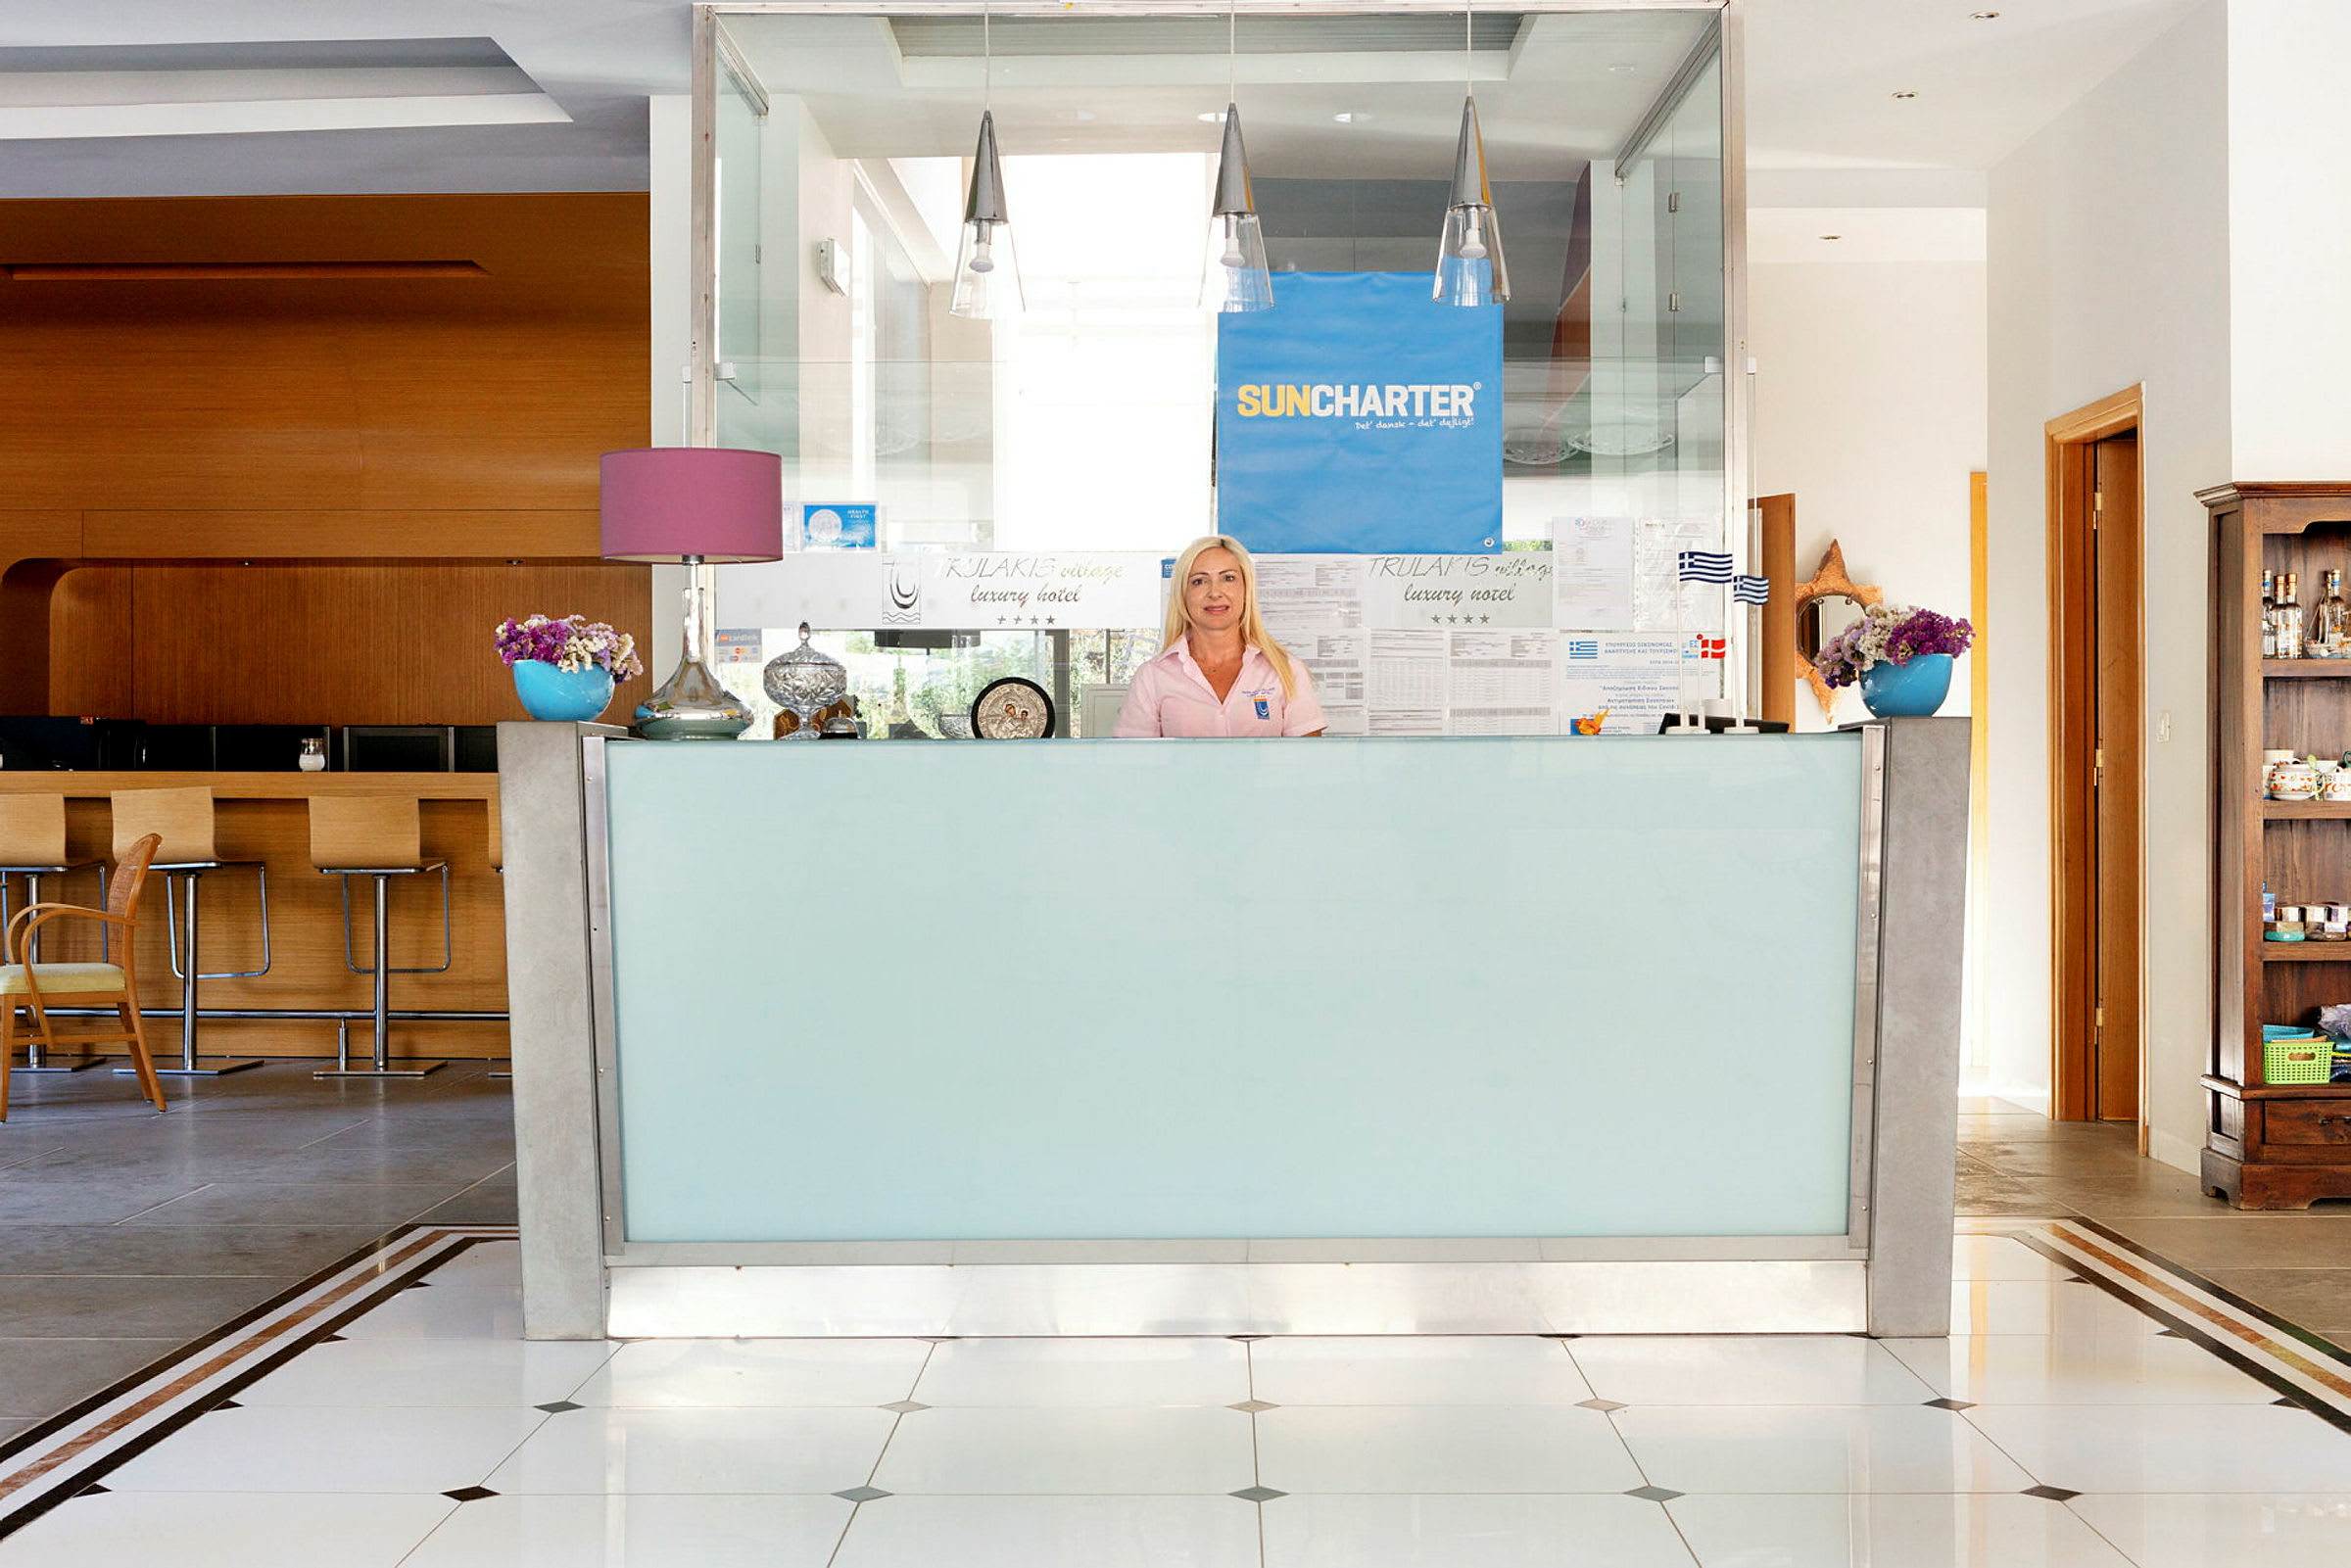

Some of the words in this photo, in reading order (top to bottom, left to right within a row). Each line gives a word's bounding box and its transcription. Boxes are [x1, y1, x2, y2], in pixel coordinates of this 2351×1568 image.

[1375, 419, 1406, 429] dansk
[970, 584, 1031, 608] luxury
[1036, 583, 1082, 602] hotel
[1403, 583, 1463, 607] luxury
